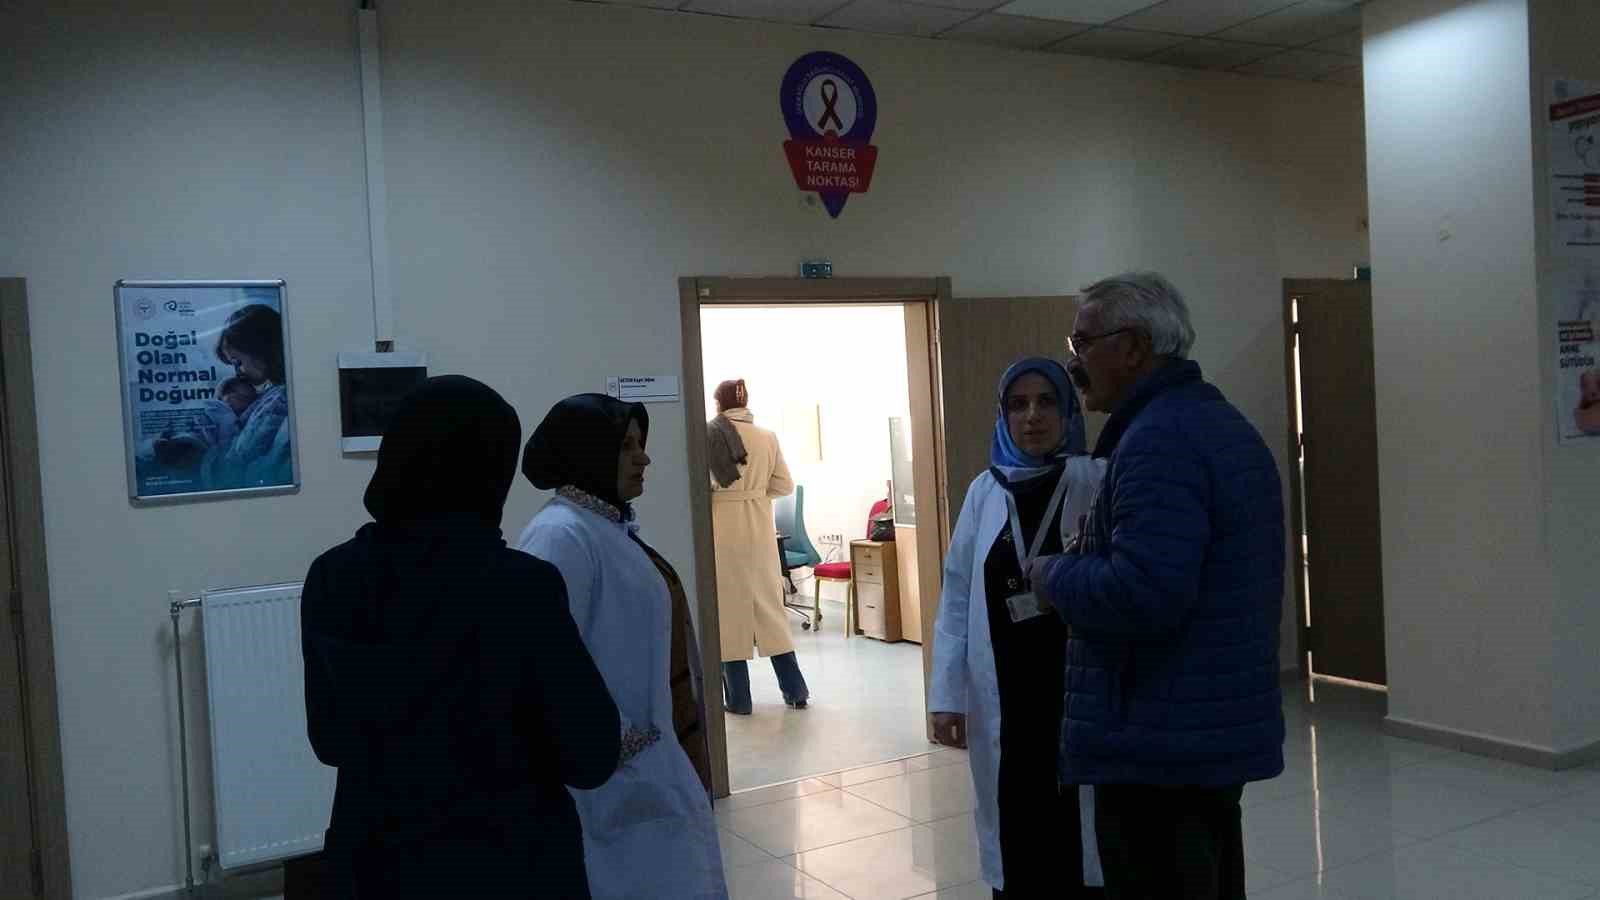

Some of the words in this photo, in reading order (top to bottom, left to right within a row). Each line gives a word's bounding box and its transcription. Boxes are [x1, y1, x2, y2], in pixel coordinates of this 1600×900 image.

[806, 146, 856, 159] KANSER
[807, 160, 857, 173] TARAMA
[135, 331, 197, 349] Doğal
[137, 350, 187, 365] Olan
[138, 366, 217, 384] Normal
[139, 385, 216, 404] Doğum
